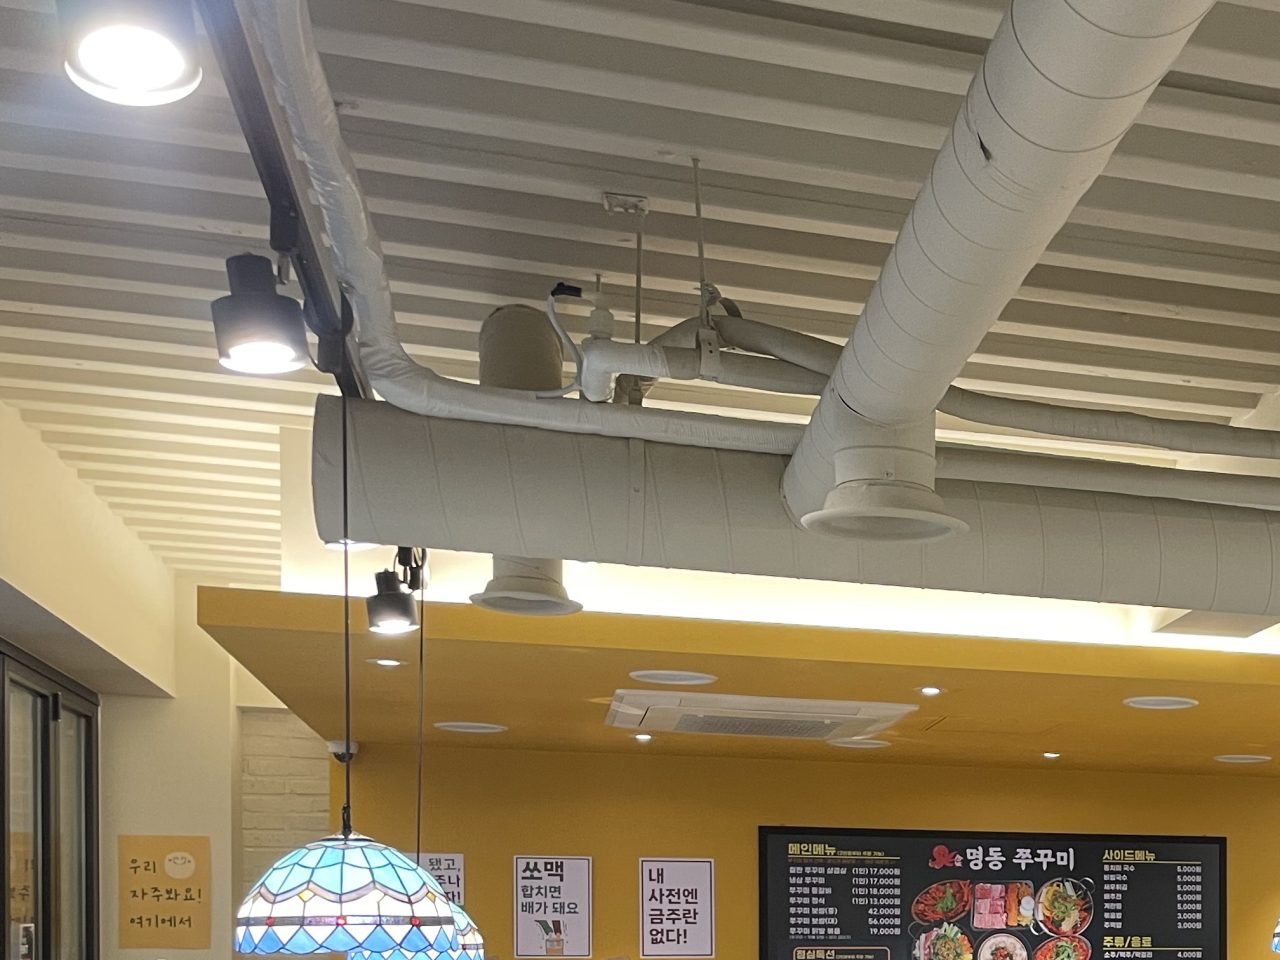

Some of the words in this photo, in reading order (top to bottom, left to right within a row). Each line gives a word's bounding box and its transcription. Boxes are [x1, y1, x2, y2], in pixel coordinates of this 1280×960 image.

[788, 843, 836, 856] 메인메뉴
[1103, 849, 1156, 861] 사이드메뉴
[428, 857, 461, 872] 됐고,
[966, 845, 1006, 871] 명동
[1012, 847, 1075, 871] 쭈꾸미
[129, 858, 156, 875] 우리
[521, 861, 564, 882] 쏘맥
[869, 867, 900, 875] 17,000원
[648, 867, 664, 884] 내
[129, 886, 202, 904] 자주봐요!
[521, 885, 561, 898] 합치면
[648, 888, 698, 905] 사전엔
[521, 901, 548, 915] 배가
[552, 901, 579, 915] 돼요
[129, 914, 192, 929] 여기에서
[648, 908, 699, 925] 금주란
[649, 928, 687, 945] 없다!
[1103, 936, 1152, 948] 주류/음료
